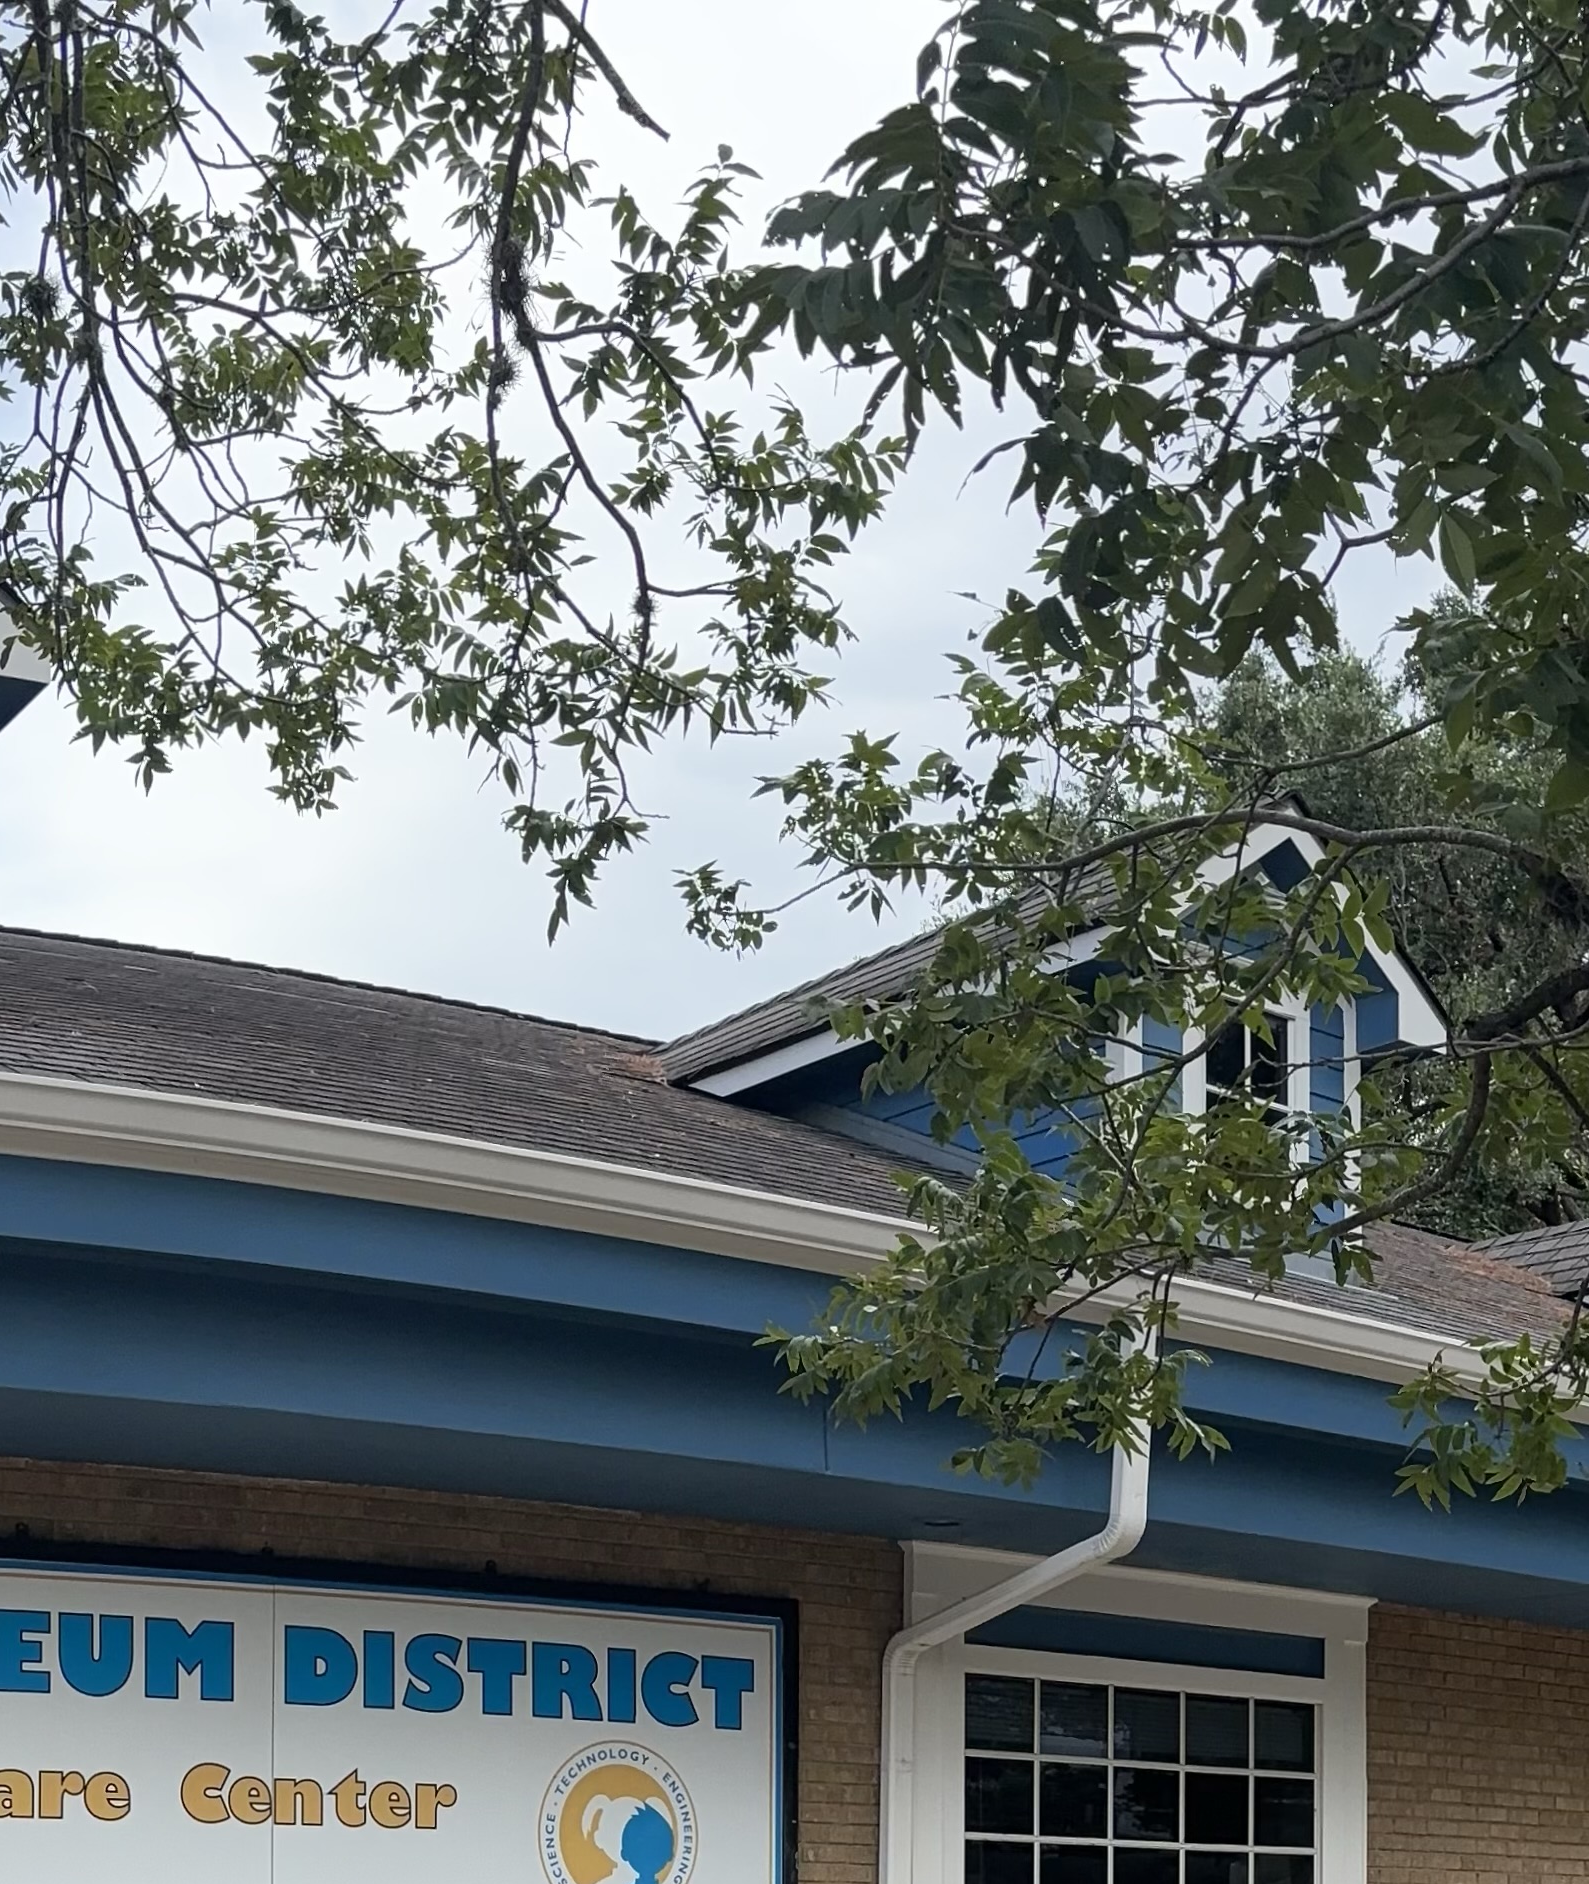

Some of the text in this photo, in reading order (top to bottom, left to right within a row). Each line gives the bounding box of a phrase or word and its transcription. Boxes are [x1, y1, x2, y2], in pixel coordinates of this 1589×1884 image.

[283, 1623, 755, 1731] DISTRICT
[180, 1762, 458, 1830] Center
[554, 1748, 650, 1796] TECHNOLOGY
